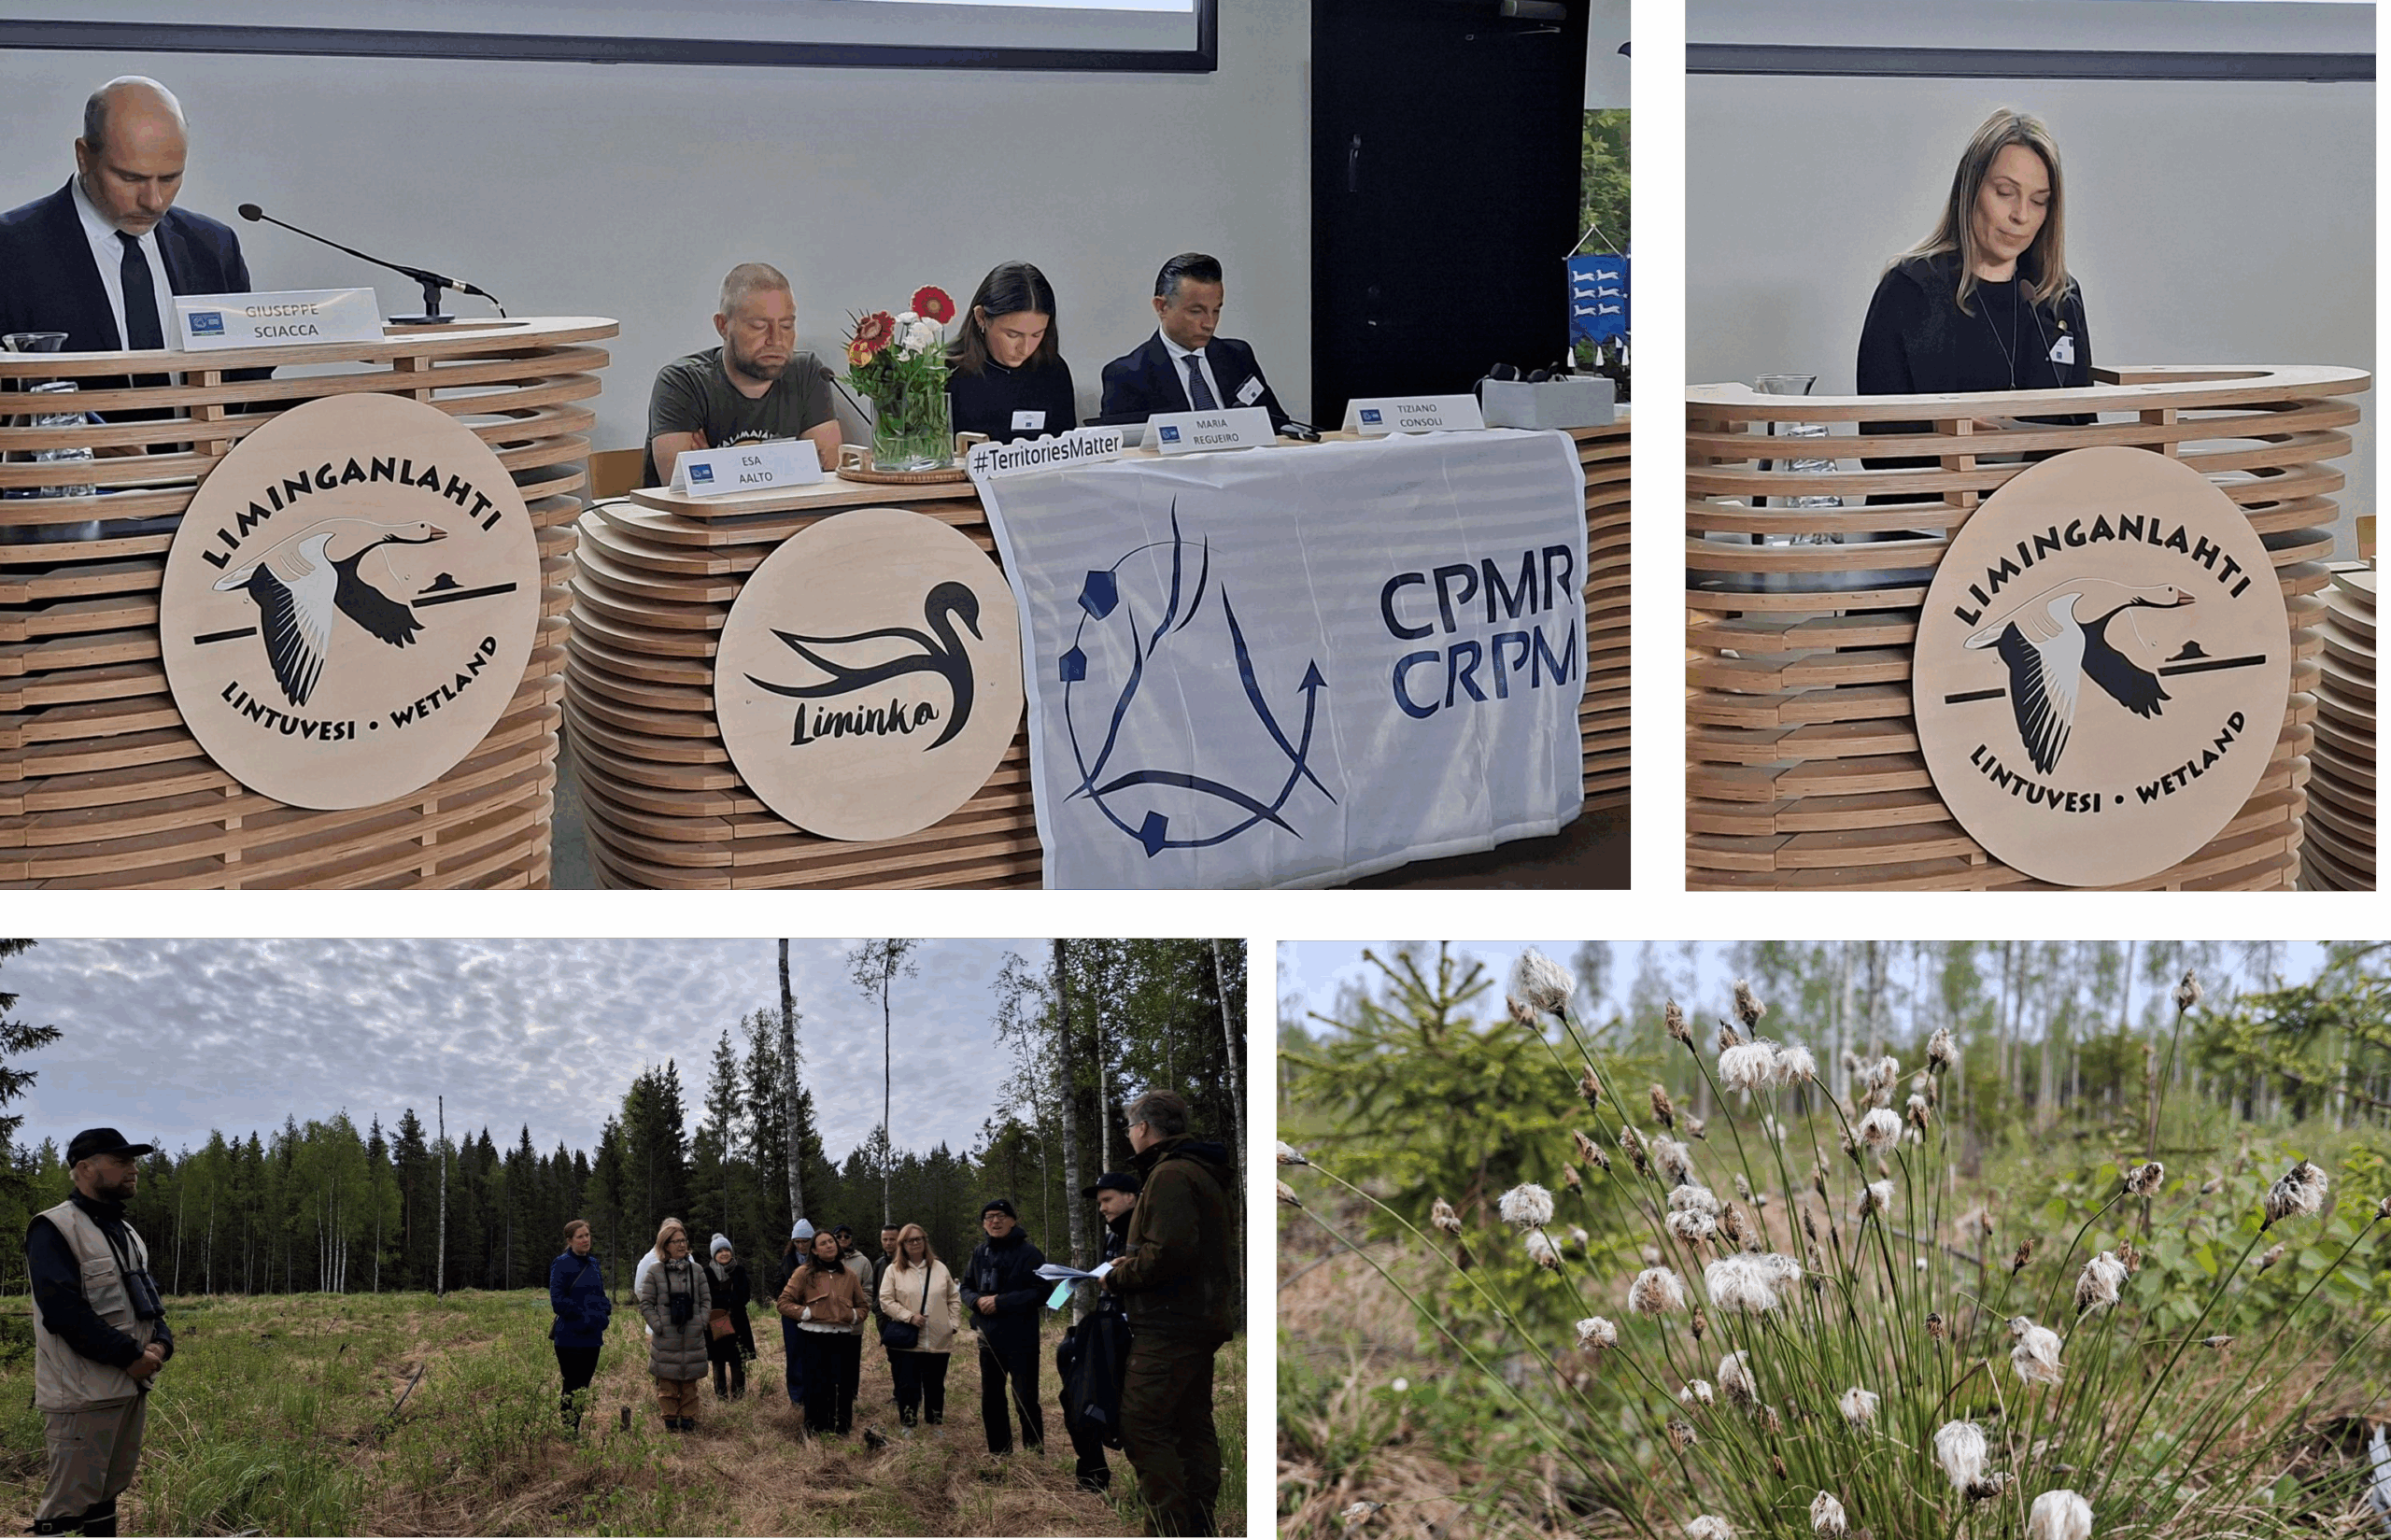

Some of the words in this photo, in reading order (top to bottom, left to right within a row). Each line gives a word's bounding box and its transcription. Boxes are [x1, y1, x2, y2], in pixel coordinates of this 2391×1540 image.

[245, 304, 319, 318] GIUSEPPE
[254, 324, 319, 338] SCIACCA
[1396, 403, 1437, 414] TIZIANO
[1196, 418, 1229, 430] MARIA
[1400, 417, 1443, 428] CONSOLI
[1193, 432, 1240, 445] REGUEIRO
[742, 455, 762, 466] ESA
[973, 434, 1120, 473] #TerritoriesMatter
[739, 472, 773, 484] AALTO
[202, 456, 502, 570] LIMINGANLAHTI
[1954, 514, 2251, 628] LIMINGANLAHTI
[1380, 544, 1575, 641] CPMR
[1392, 617, 1577, 720] CRPM
[220, 681, 355, 741] LINTUVESI
[389, 636, 498, 729] WETLAND
[790, 697, 941, 746] Liminka
[1970, 743, 2101, 813] LINTUVESI
[2135, 711, 2245, 805] WETLAND
